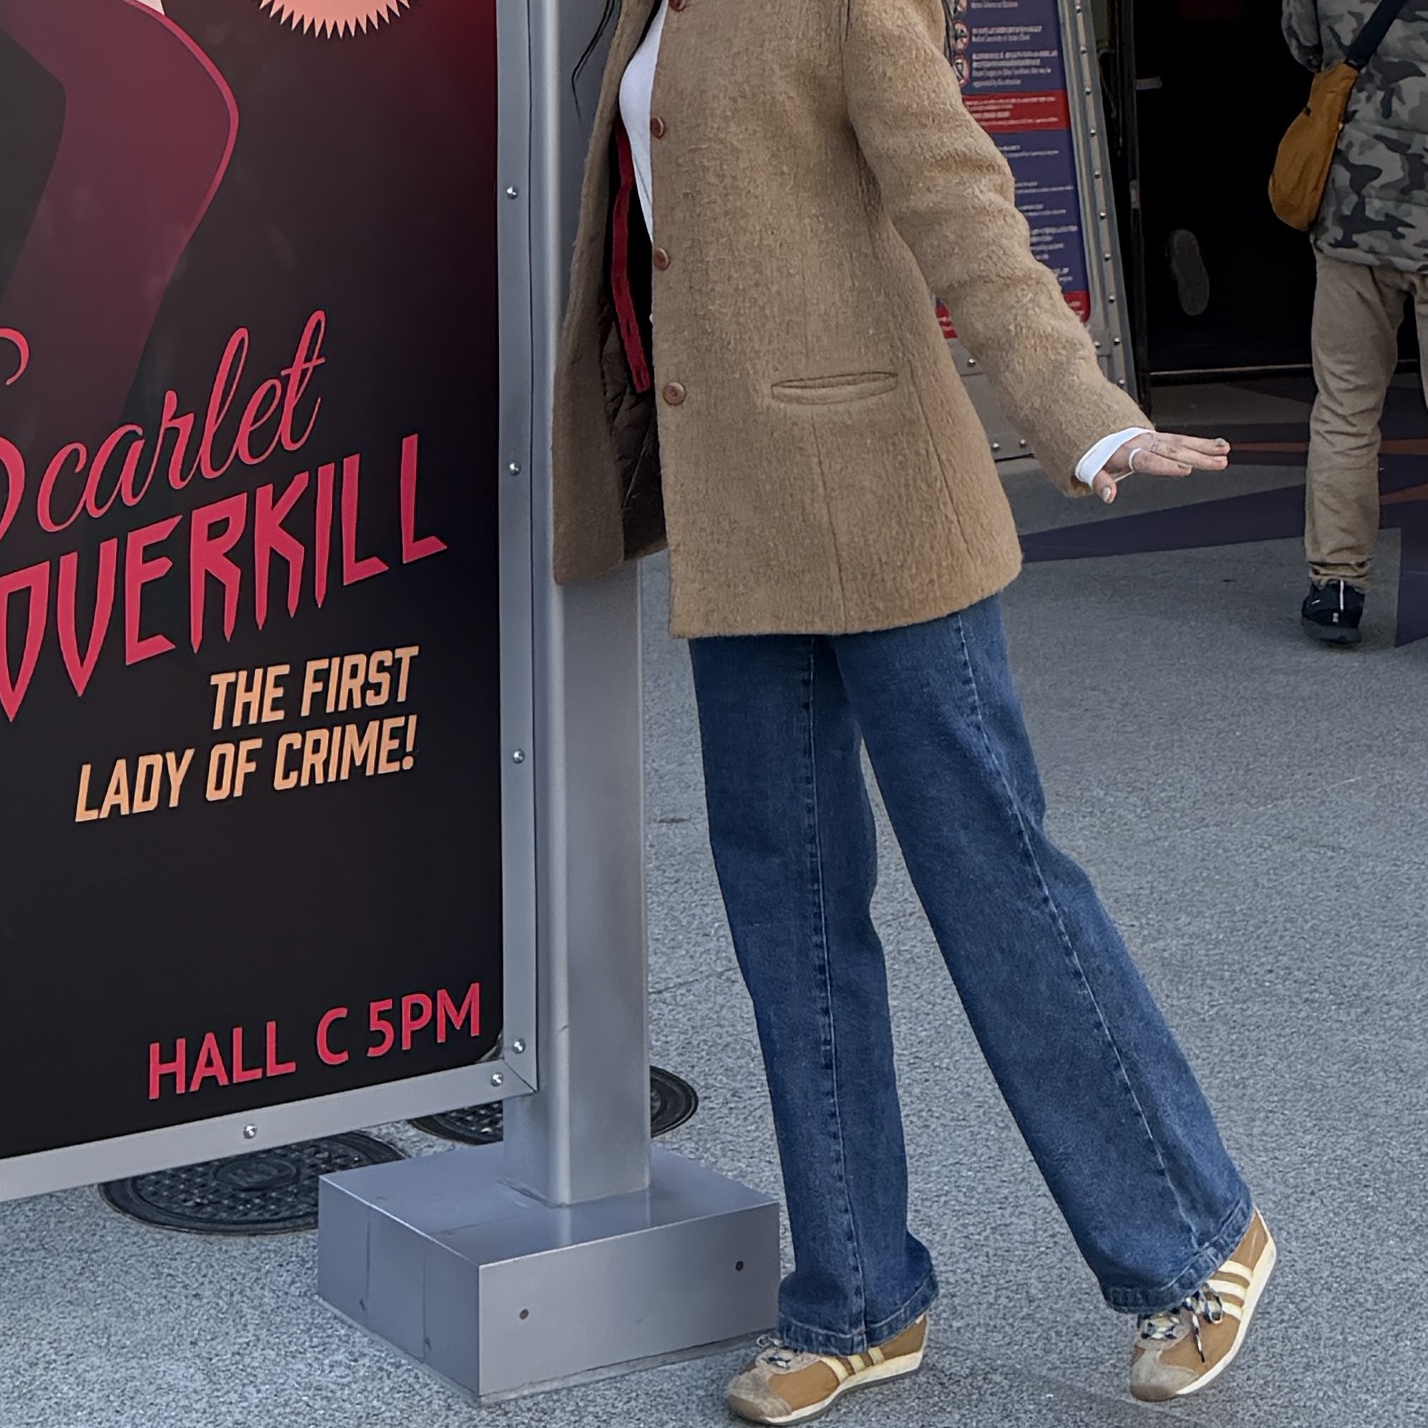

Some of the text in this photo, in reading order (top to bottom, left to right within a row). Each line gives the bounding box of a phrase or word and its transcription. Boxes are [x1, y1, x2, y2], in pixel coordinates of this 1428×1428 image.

[209, 645, 420, 731] THE FIRST
[74, 713, 419, 823] LADY OF CRIME!
[148, 981, 481, 1100] HALL C 5PM
